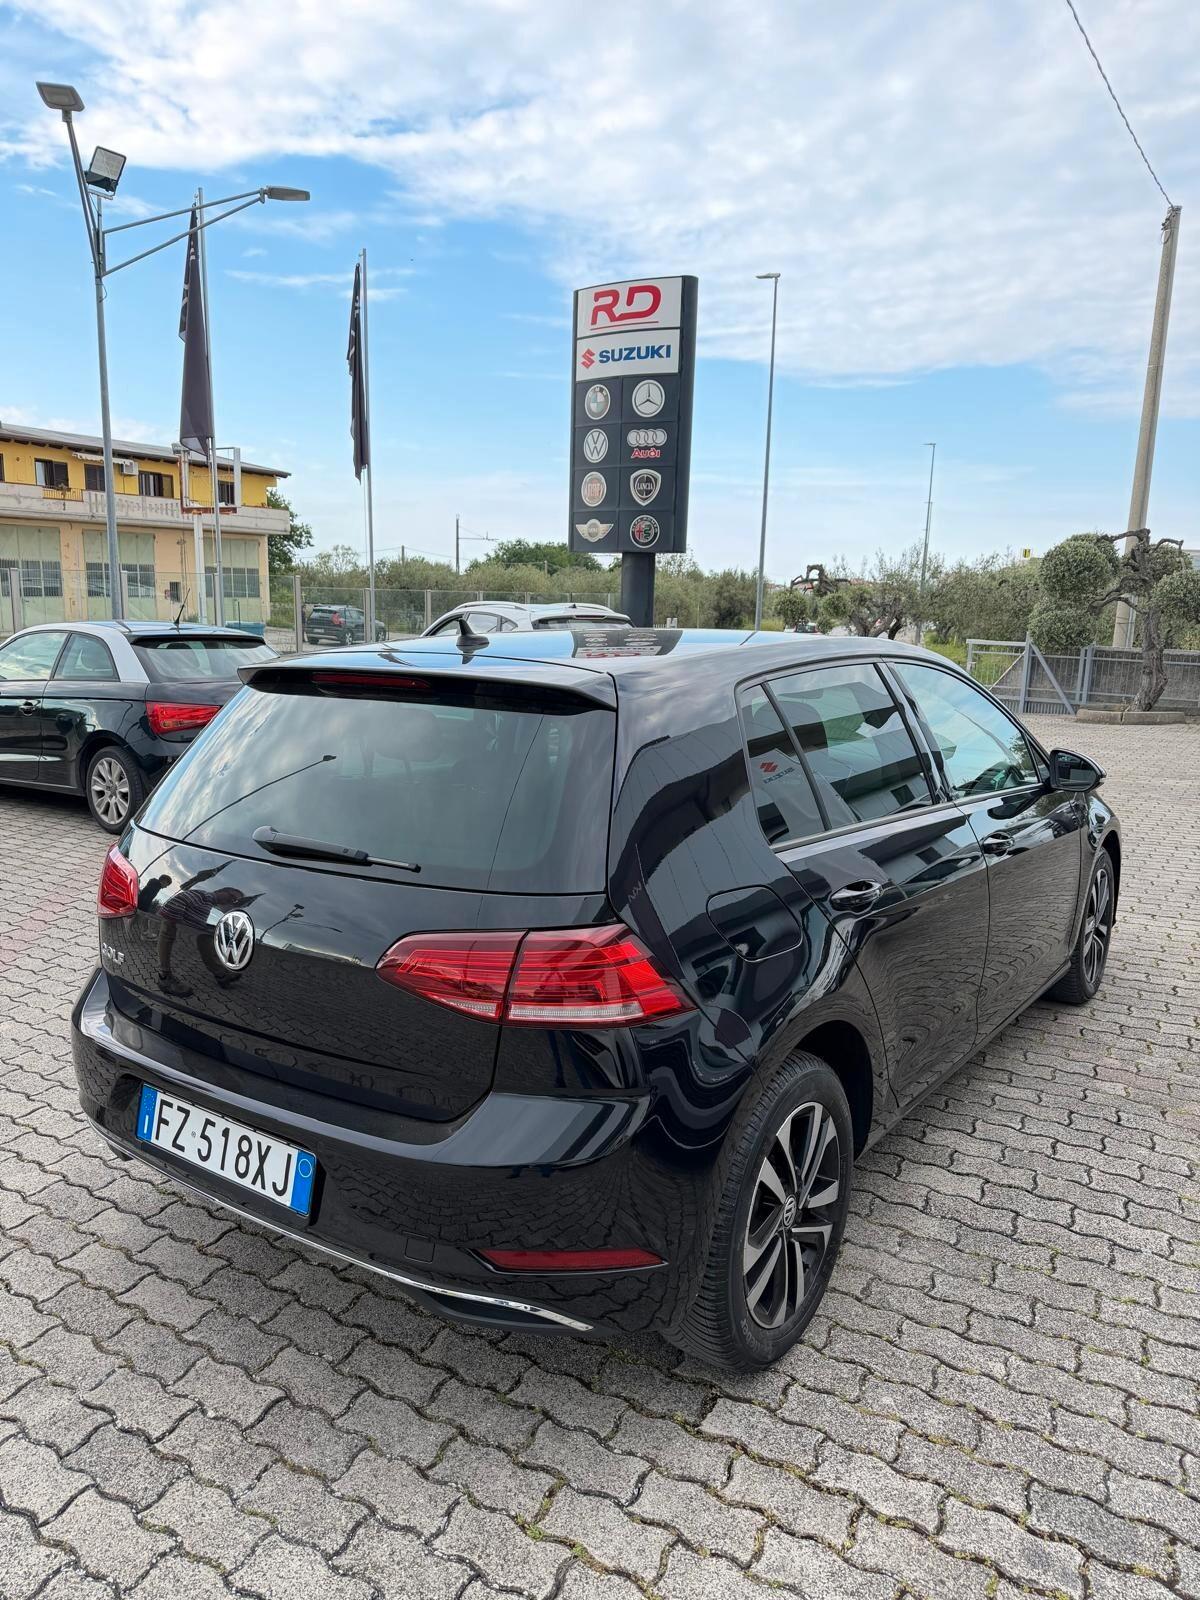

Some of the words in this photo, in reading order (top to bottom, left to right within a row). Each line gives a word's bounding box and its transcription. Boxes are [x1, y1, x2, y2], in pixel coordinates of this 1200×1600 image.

[590, 284, 661, 325] RD
[598, 344, 672, 364] SUZUKI
[631, 448, 661, 458] Audi
[155, 1098, 191, 1153] FZ
[197, 1117, 292, 1197] 518XJ
